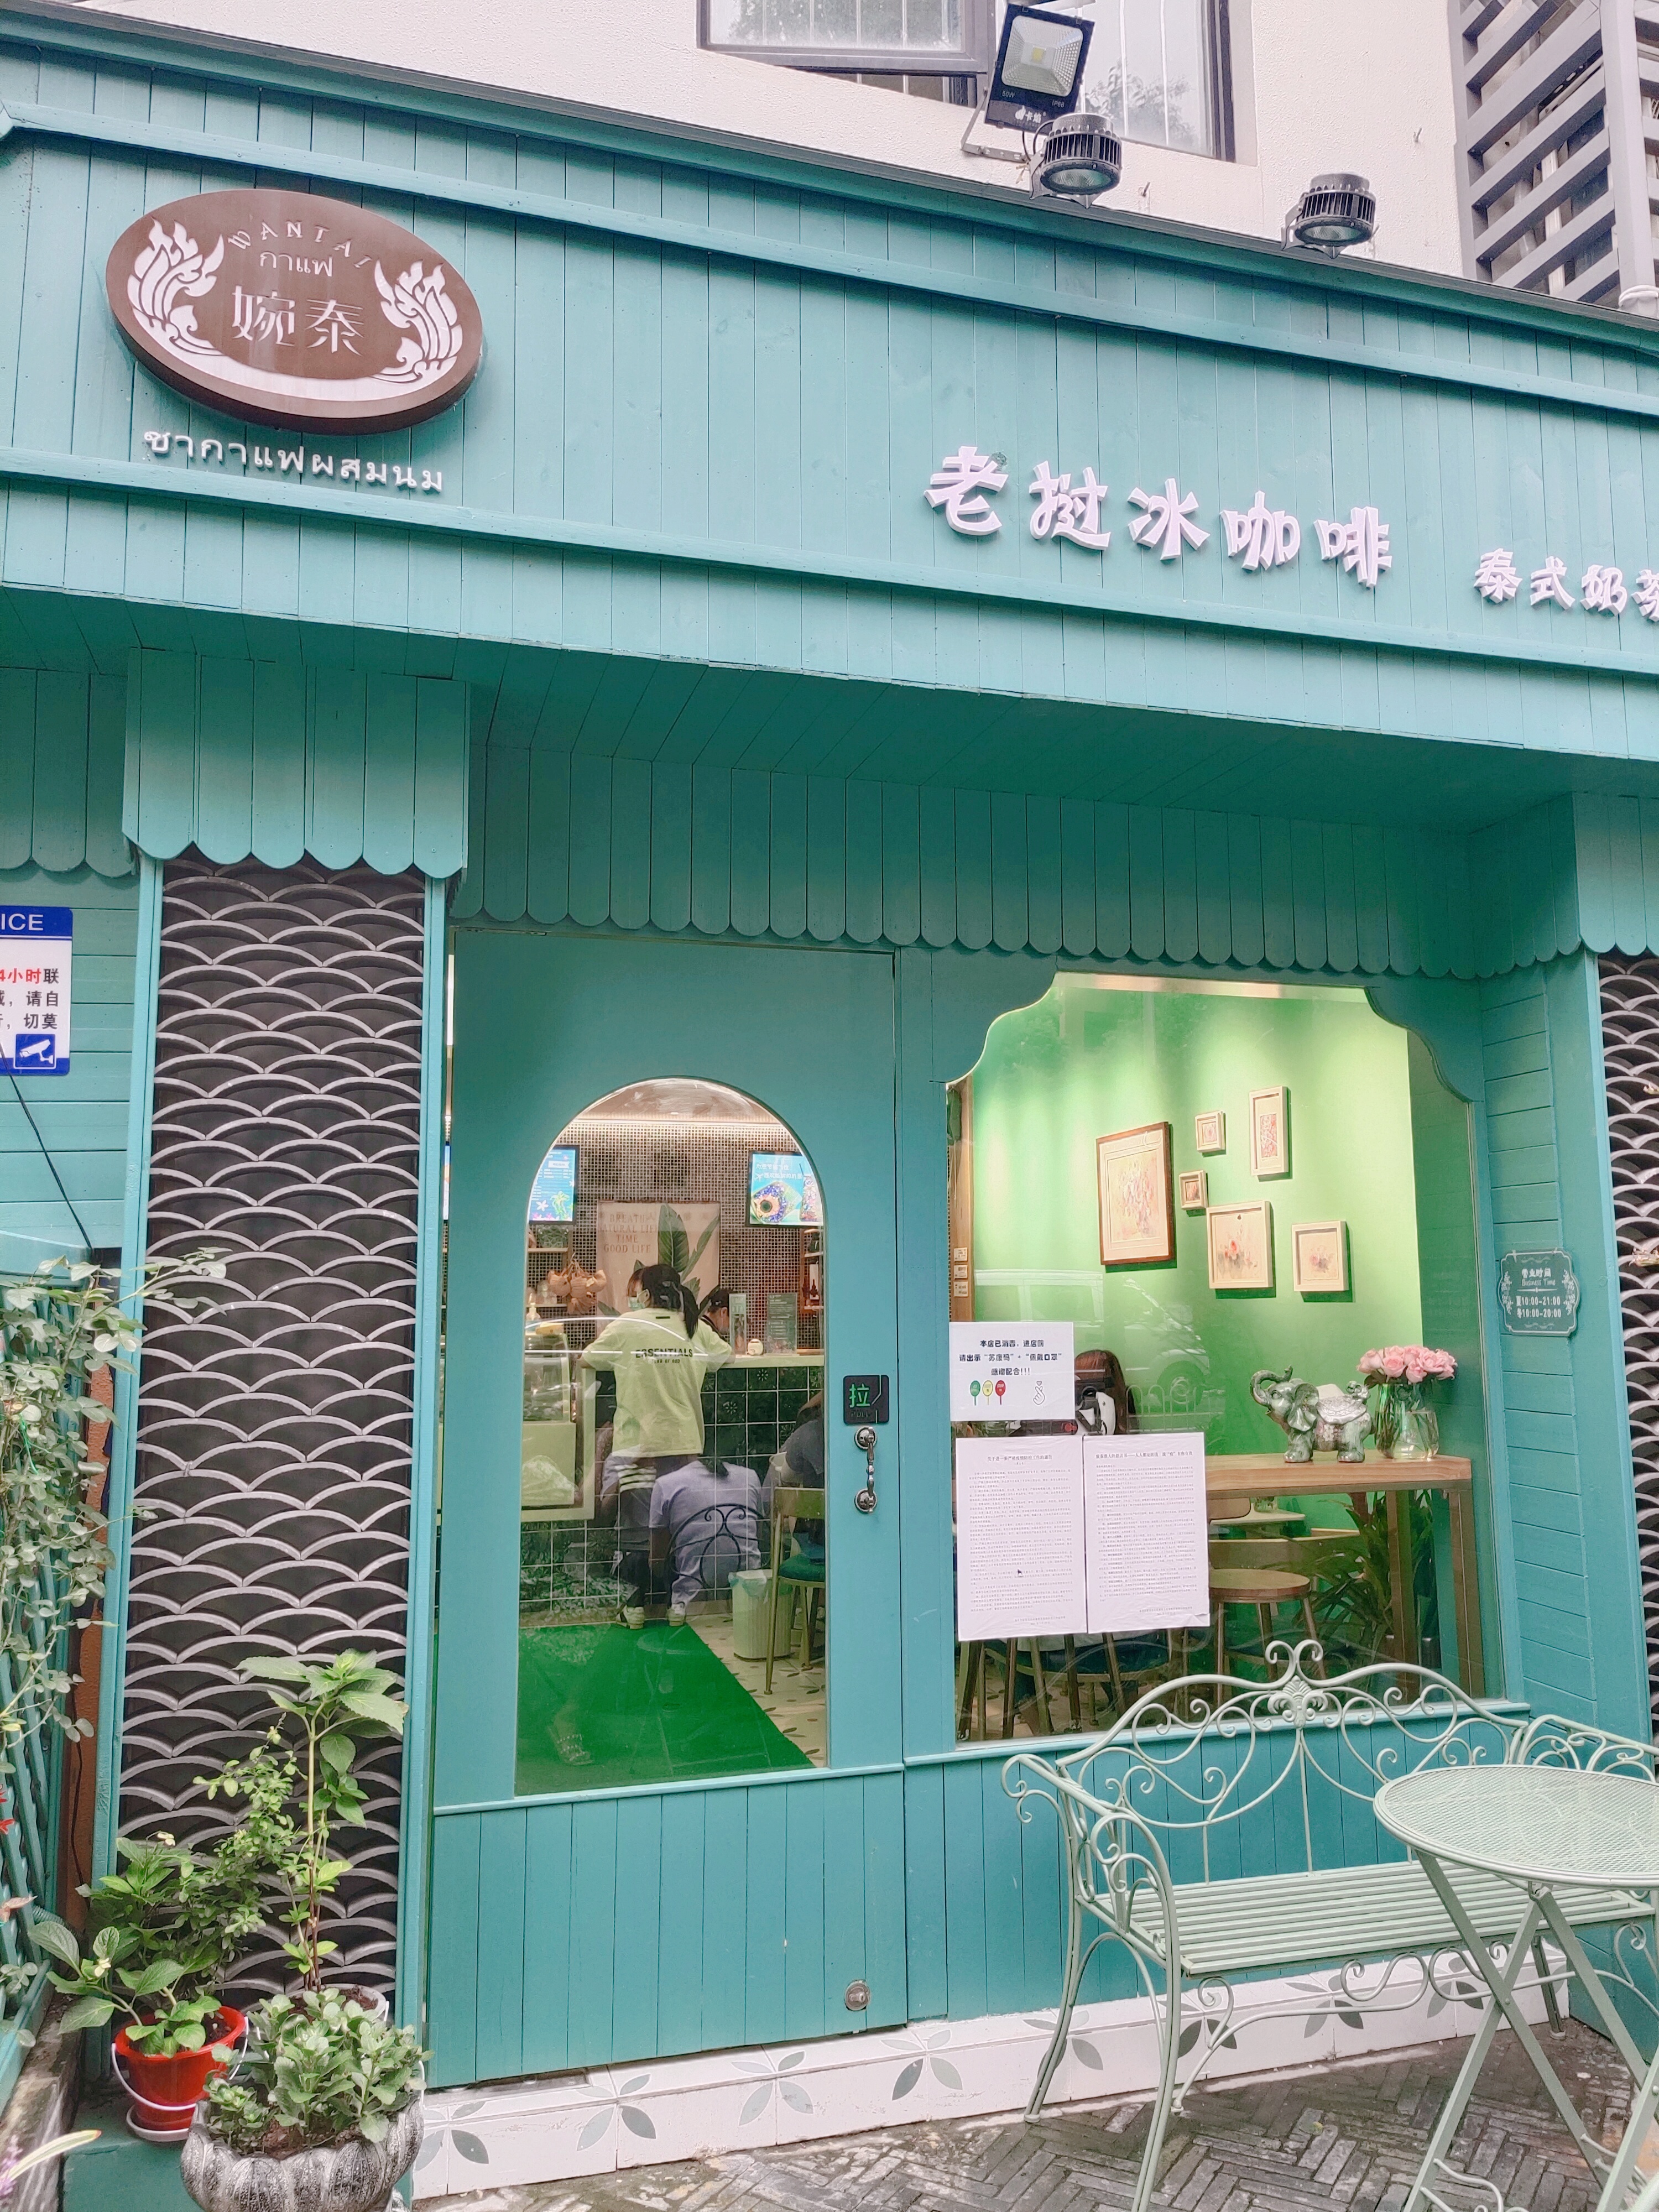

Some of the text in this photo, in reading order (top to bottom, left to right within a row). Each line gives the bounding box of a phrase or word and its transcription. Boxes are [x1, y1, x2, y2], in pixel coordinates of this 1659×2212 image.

[259, 251, 333, 277] กาแฟ
[924, 446, 1392, 589] 老挝冰咖啡
[616, 1234, 638, 1243] TIME
[604, 1244, 651, 1254] GOOD LIFE
[1521, 1277, 1556, 1287] Business Time
[635, 1348, 693, 1358] ESSENTIALS
[849, 1383, 870, 1408] 拉
